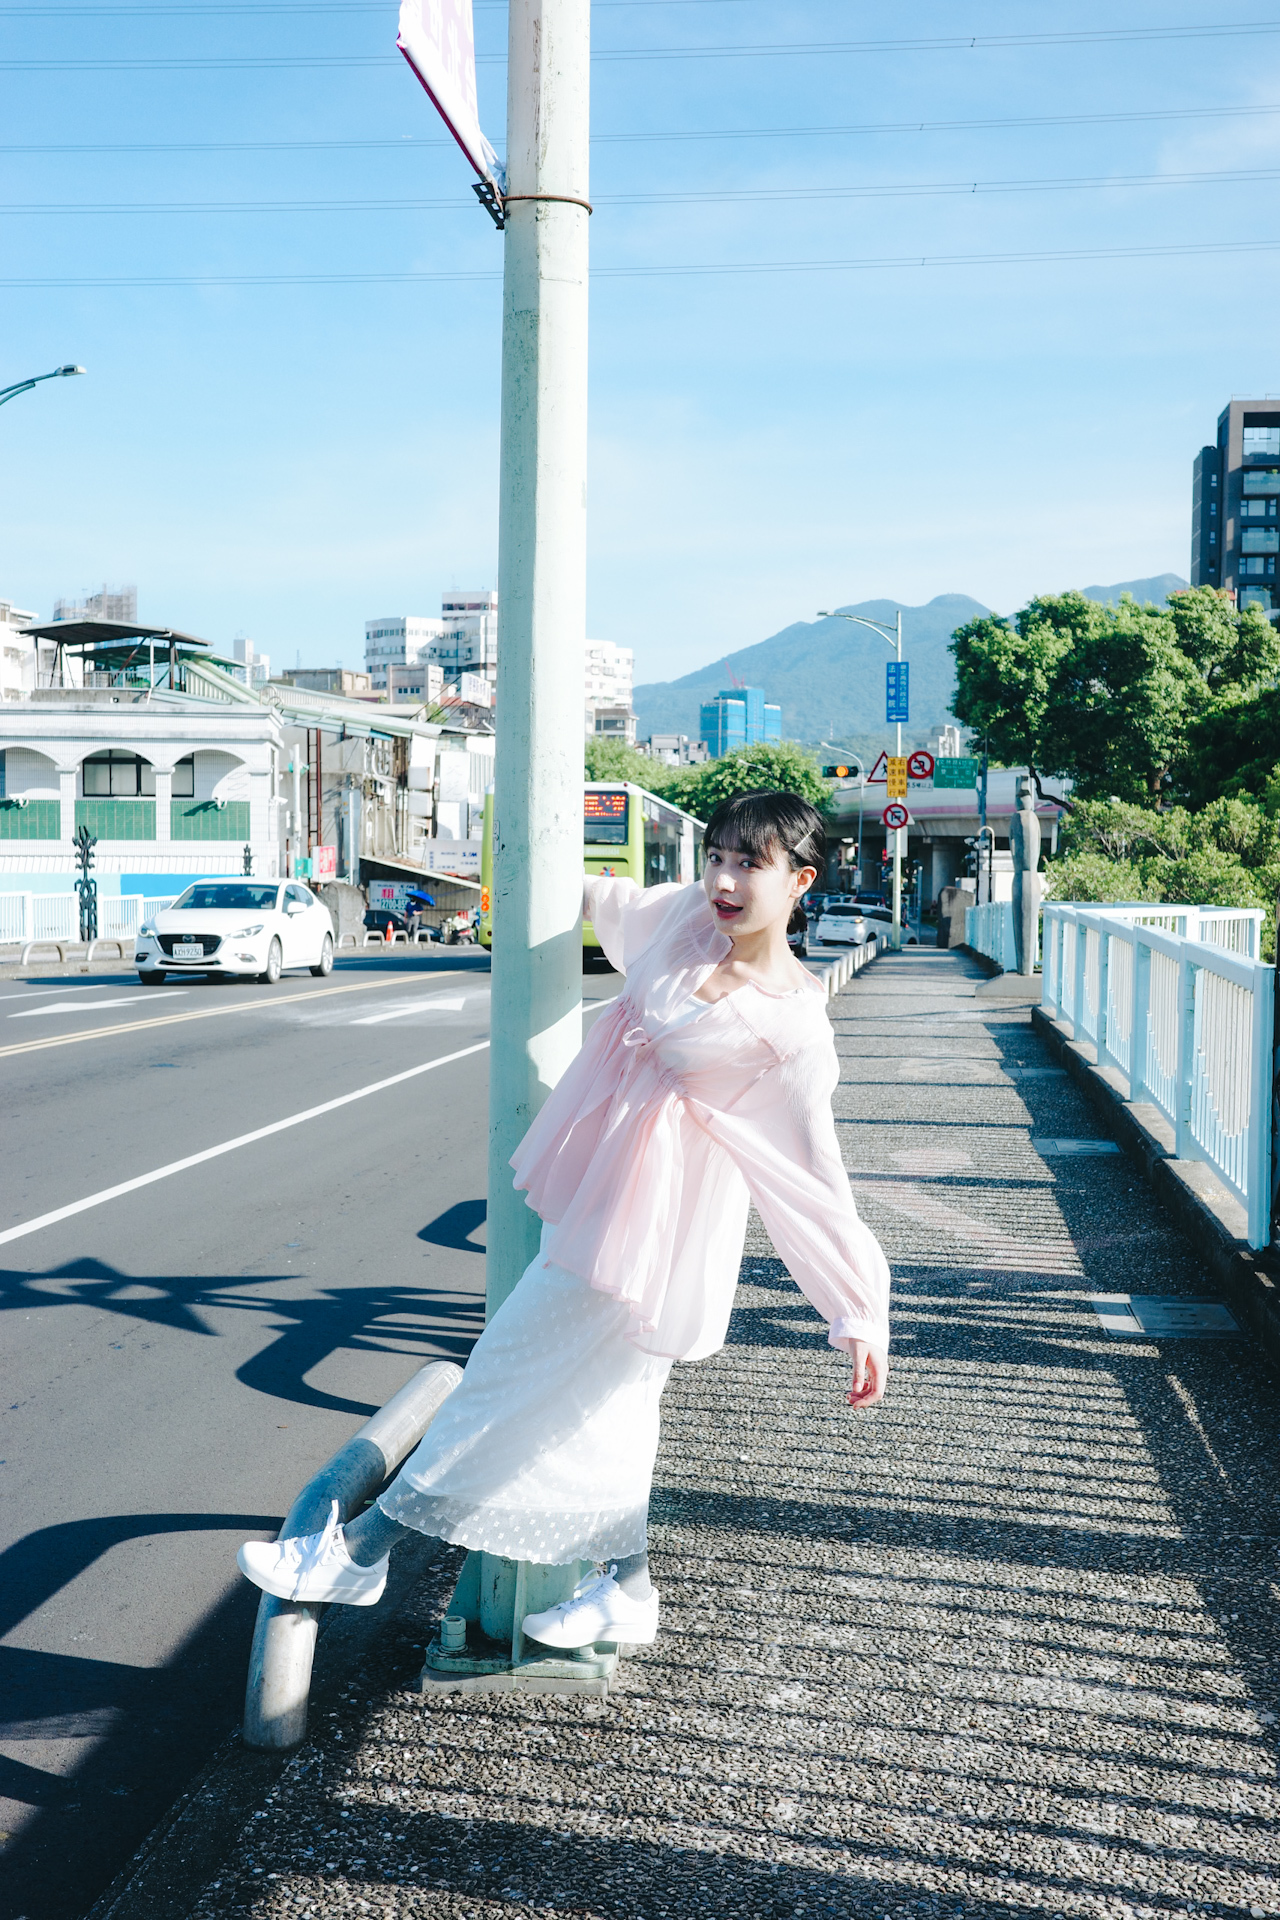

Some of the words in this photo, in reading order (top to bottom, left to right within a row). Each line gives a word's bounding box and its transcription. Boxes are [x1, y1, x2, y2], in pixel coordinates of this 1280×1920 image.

[889, 759, 897, 796] 減速慢行
[897, 759, 906, 796] 右轉車輛
